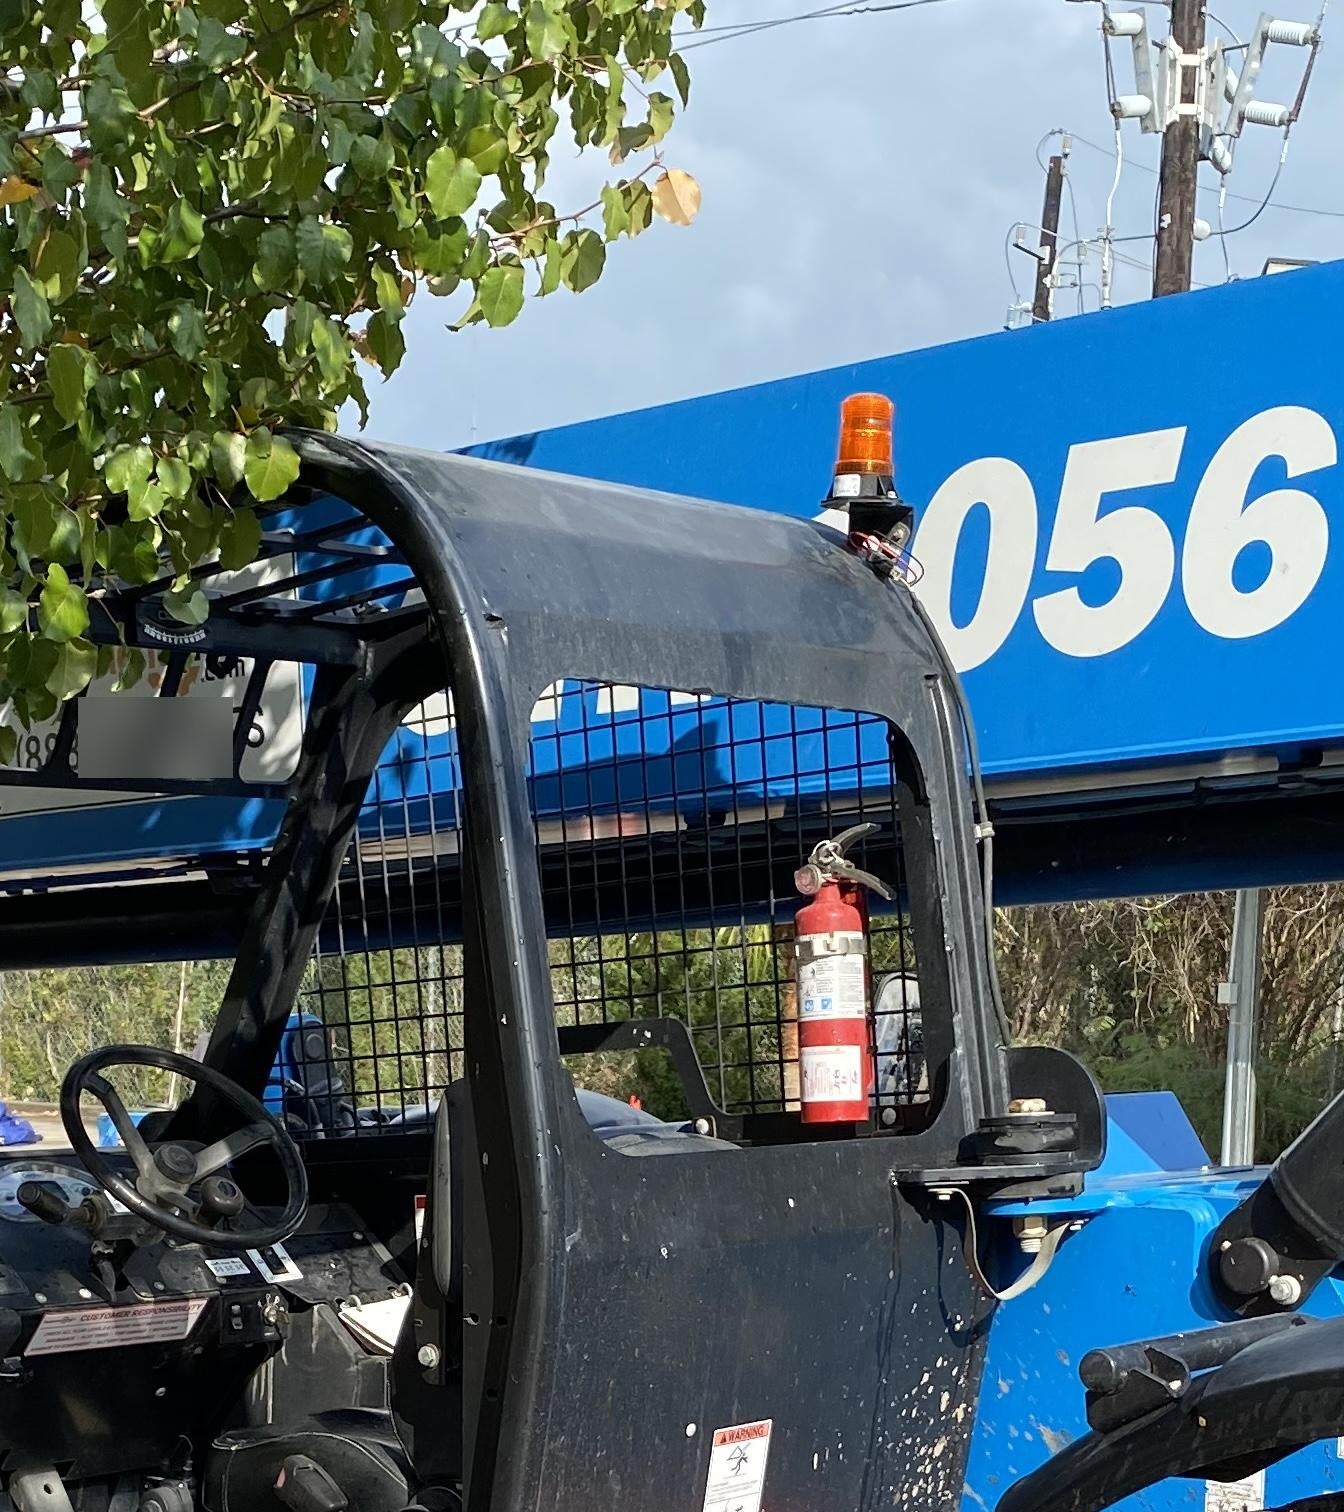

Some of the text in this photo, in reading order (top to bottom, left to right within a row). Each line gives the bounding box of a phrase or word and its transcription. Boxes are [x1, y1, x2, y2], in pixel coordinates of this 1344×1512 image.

[811, 405, 1338, 674] 056
[79, 1309, 132, 1322] CUSTOMER
[131, 1303, 202, 1318] RESPONSIBILITY
[727, 1424, 765, 1442] WARNING
